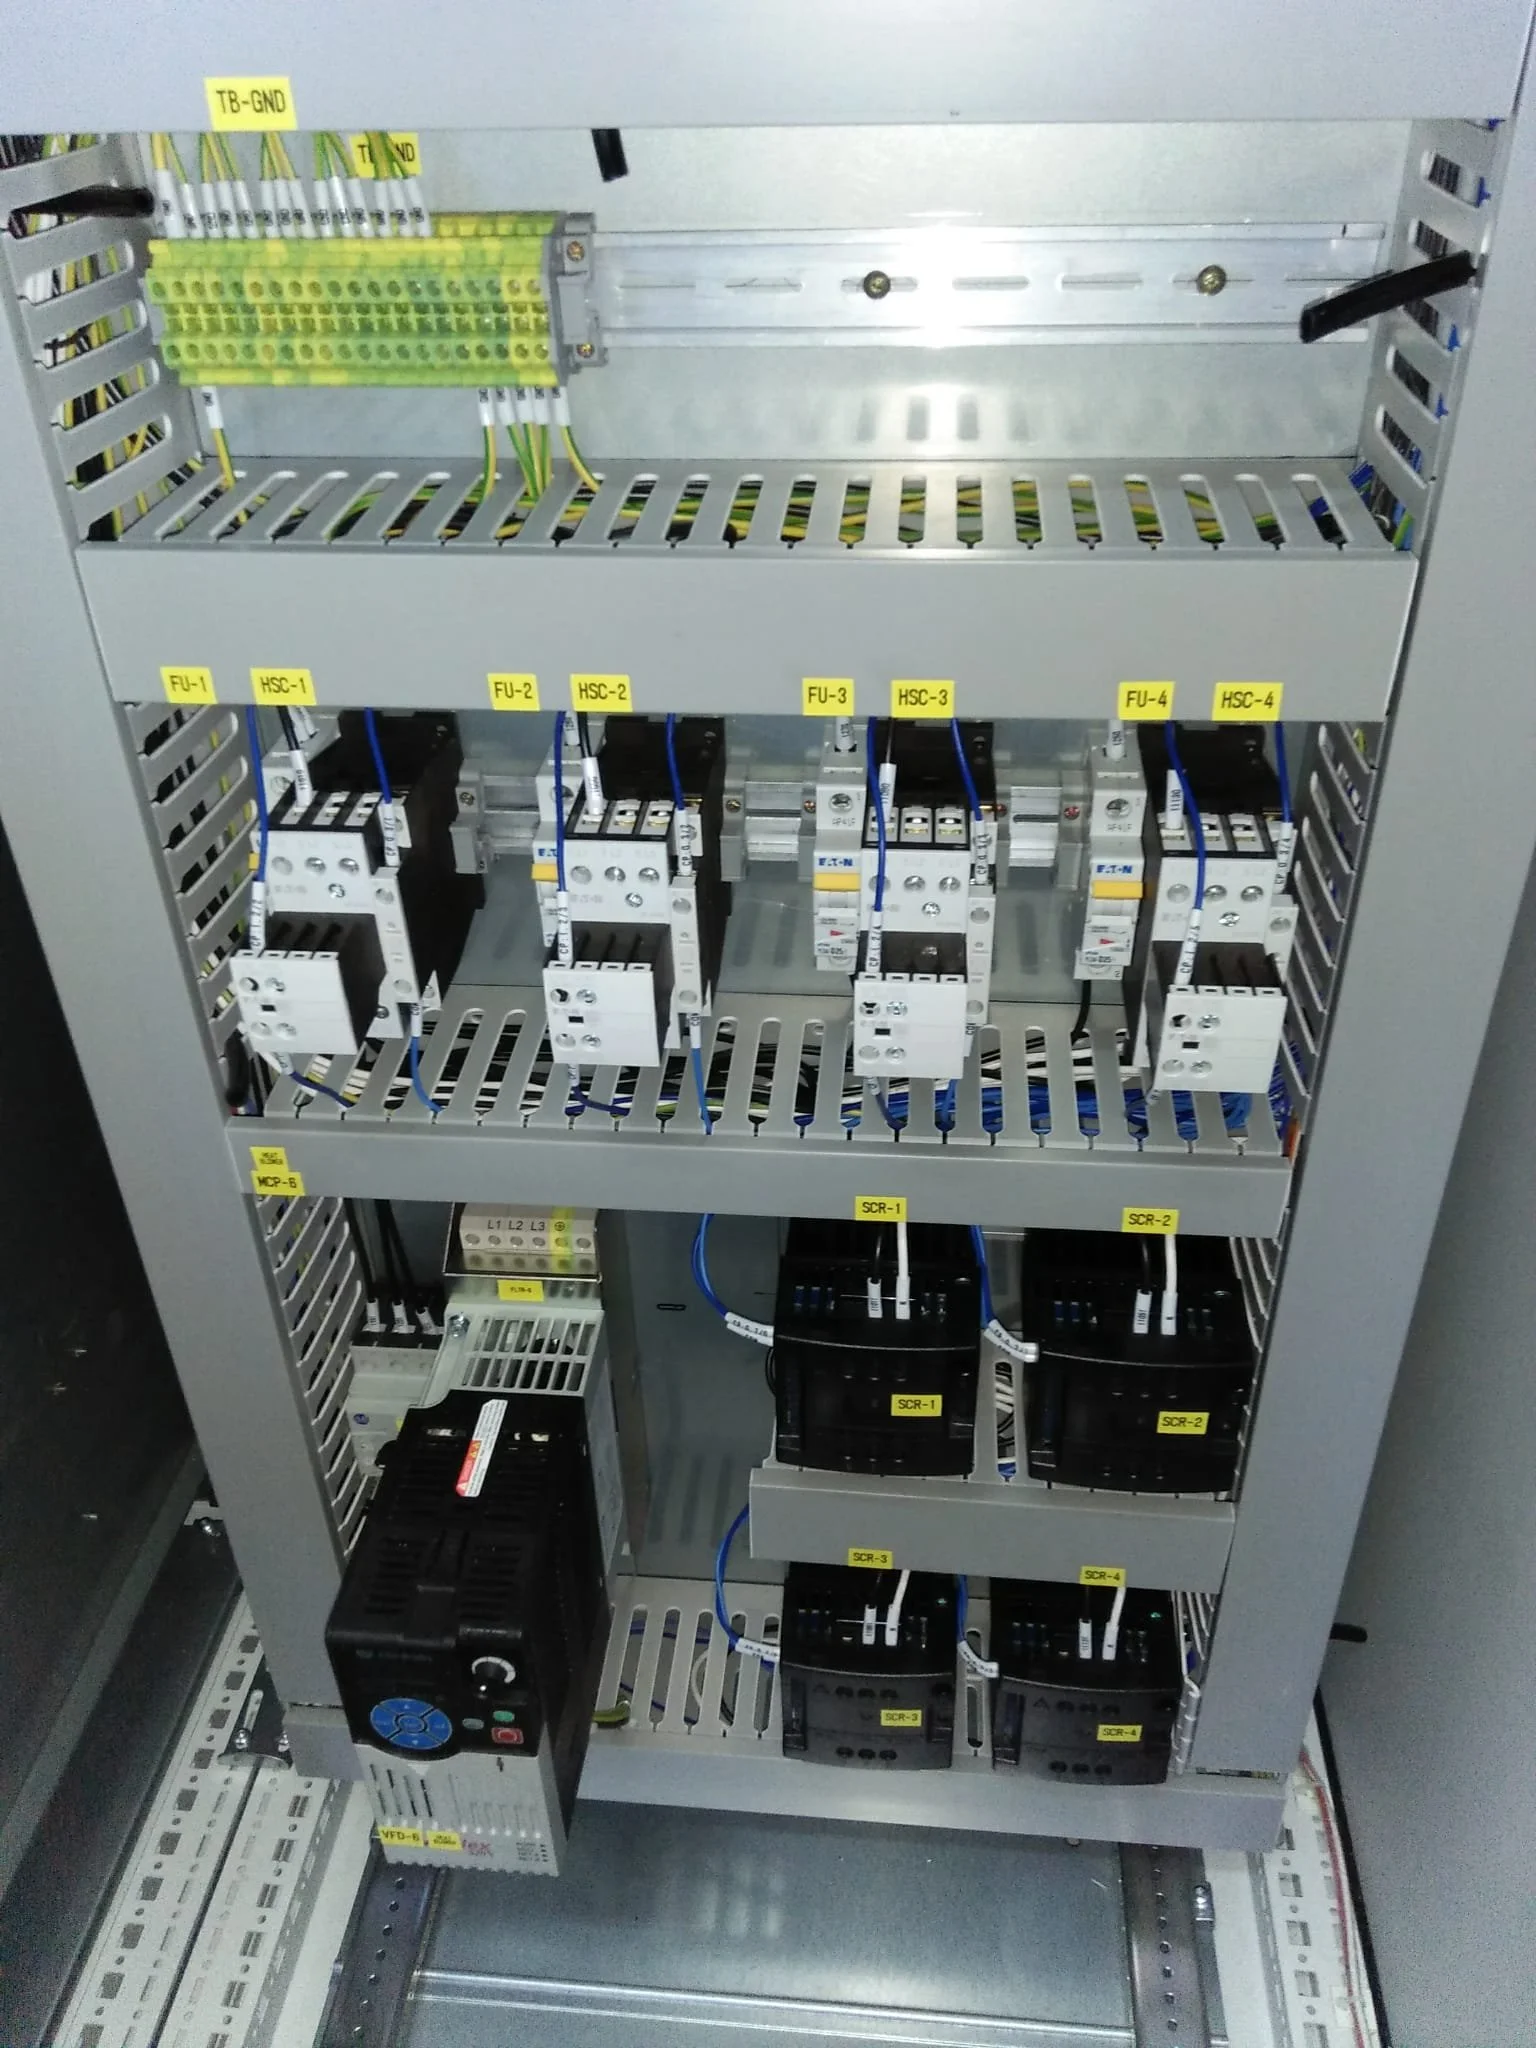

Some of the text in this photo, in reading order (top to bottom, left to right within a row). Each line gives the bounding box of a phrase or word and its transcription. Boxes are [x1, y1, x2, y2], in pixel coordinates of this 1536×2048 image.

[215, 89, 286, 114] TB-GND
[169, 675, 206, 693] FU-1
[260, 676, 306, 694] HSC-1
[493, 681, 533, 700] FU-2
[578, 682, 627, 701] HSC-2
[808, 686, 847, 704] FU-3
[898, 688, 948, 706] HSC-3
[1126, 690, 1168, 708] FU-4
[1221, 690, 1274, 709] HSC-4
[257, 1175, 297, 1189] MCP-6
[862, 1201, 901, 1215] SCR-1
[488, 1220, 501, 1230] L1
[508, 1220, 524, 1231] L2
[531, 1221, 546, 1232] L3
[1128, 1213, 1171, 1227] SCR-2
[897, 1398, 936, 1411] SCR-1
[1161, 1416, 1203, 1428] SCR-2
[853, 1552, 888, 1564] SCR-3
[1084, 1569, 1121, 1581] SCR-4
[885, 1712, 919, 1722] SCR-3
[1102, 1727, 1137, 1737] SCR-4
[381, 1829, 420, 1843] VFD-6
